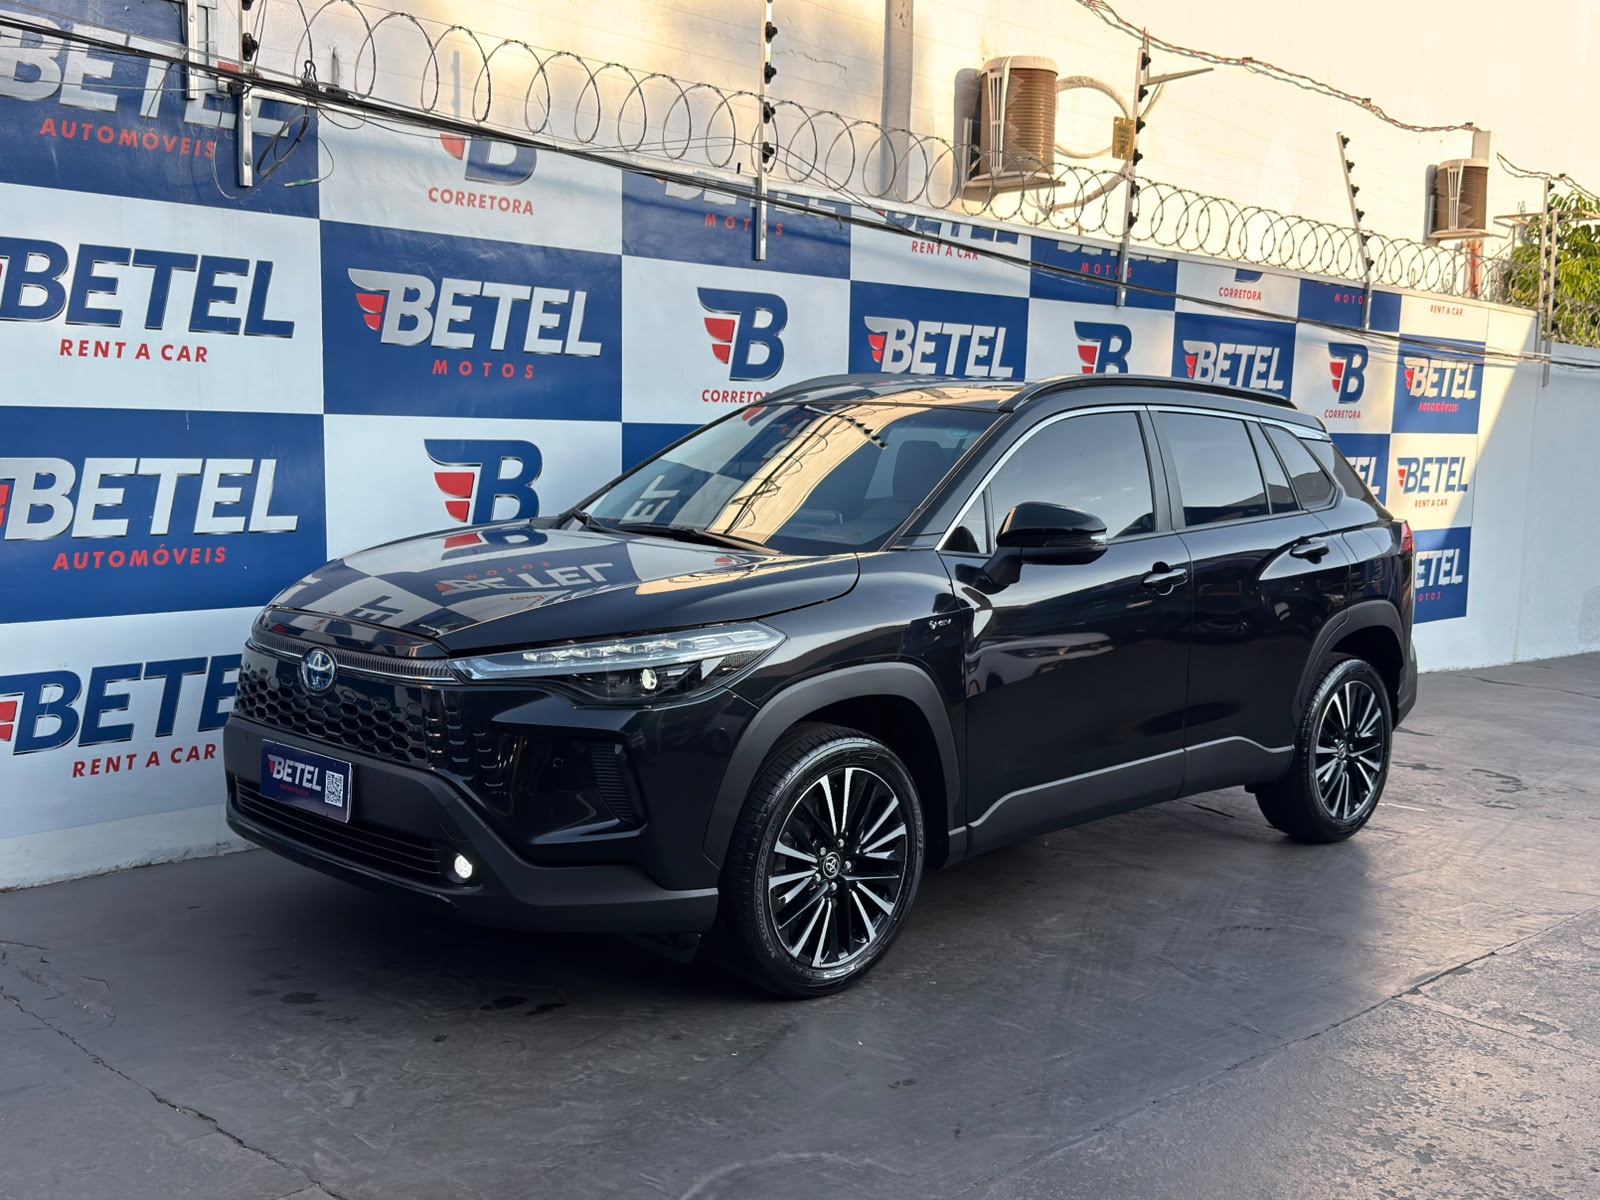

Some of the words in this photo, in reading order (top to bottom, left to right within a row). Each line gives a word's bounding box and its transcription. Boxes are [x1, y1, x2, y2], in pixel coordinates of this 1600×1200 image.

[40, 117, 217, 159] AUTOMÓVEIS
[428, 187, 534, 216] CORRETORA
[705, 213, 784, 236] MOTS
[911, 240, 942, 256] RENT
[945, 245, 953, 257] A
[0, 236, 295, 339] BETEL
[1218, 287, 1262, 301] CORRETORA
[1334, 293, 1365, 305] MOTO
[347, 268, 602, 358] BETEL
[59, 338, 126, 359] RENT
[135, 342, 151, 360] A
[160, 344, 208, 363] CAR
[864, 316, 1014, 378] BETEL
[432, 360, 534, 380] MOTOS
[1182, 340, 1284, 391] BETEL
[1404, 357, 1476, 400] BETEL
[702, 389, 771, 403] CORRETO
[1324, 409, 1362, 419] CORRETORA
[1397, 456, 1468, 494] BETEL
[0, 457, 298, 540] BETEL
[53, 544, 226, 571] AUTOMÓVEIS
[1415, 548, 1463, 590] ETEL
[1418, 591, 1442, 603] OTOS
[0, 654, 243, 756] BETE
[72, 753, 137, 778] RENT
[145, 751, 160, 768] A
[170, 743, 217, 765] CAR
[267, 754, 322, 792] BETEL
